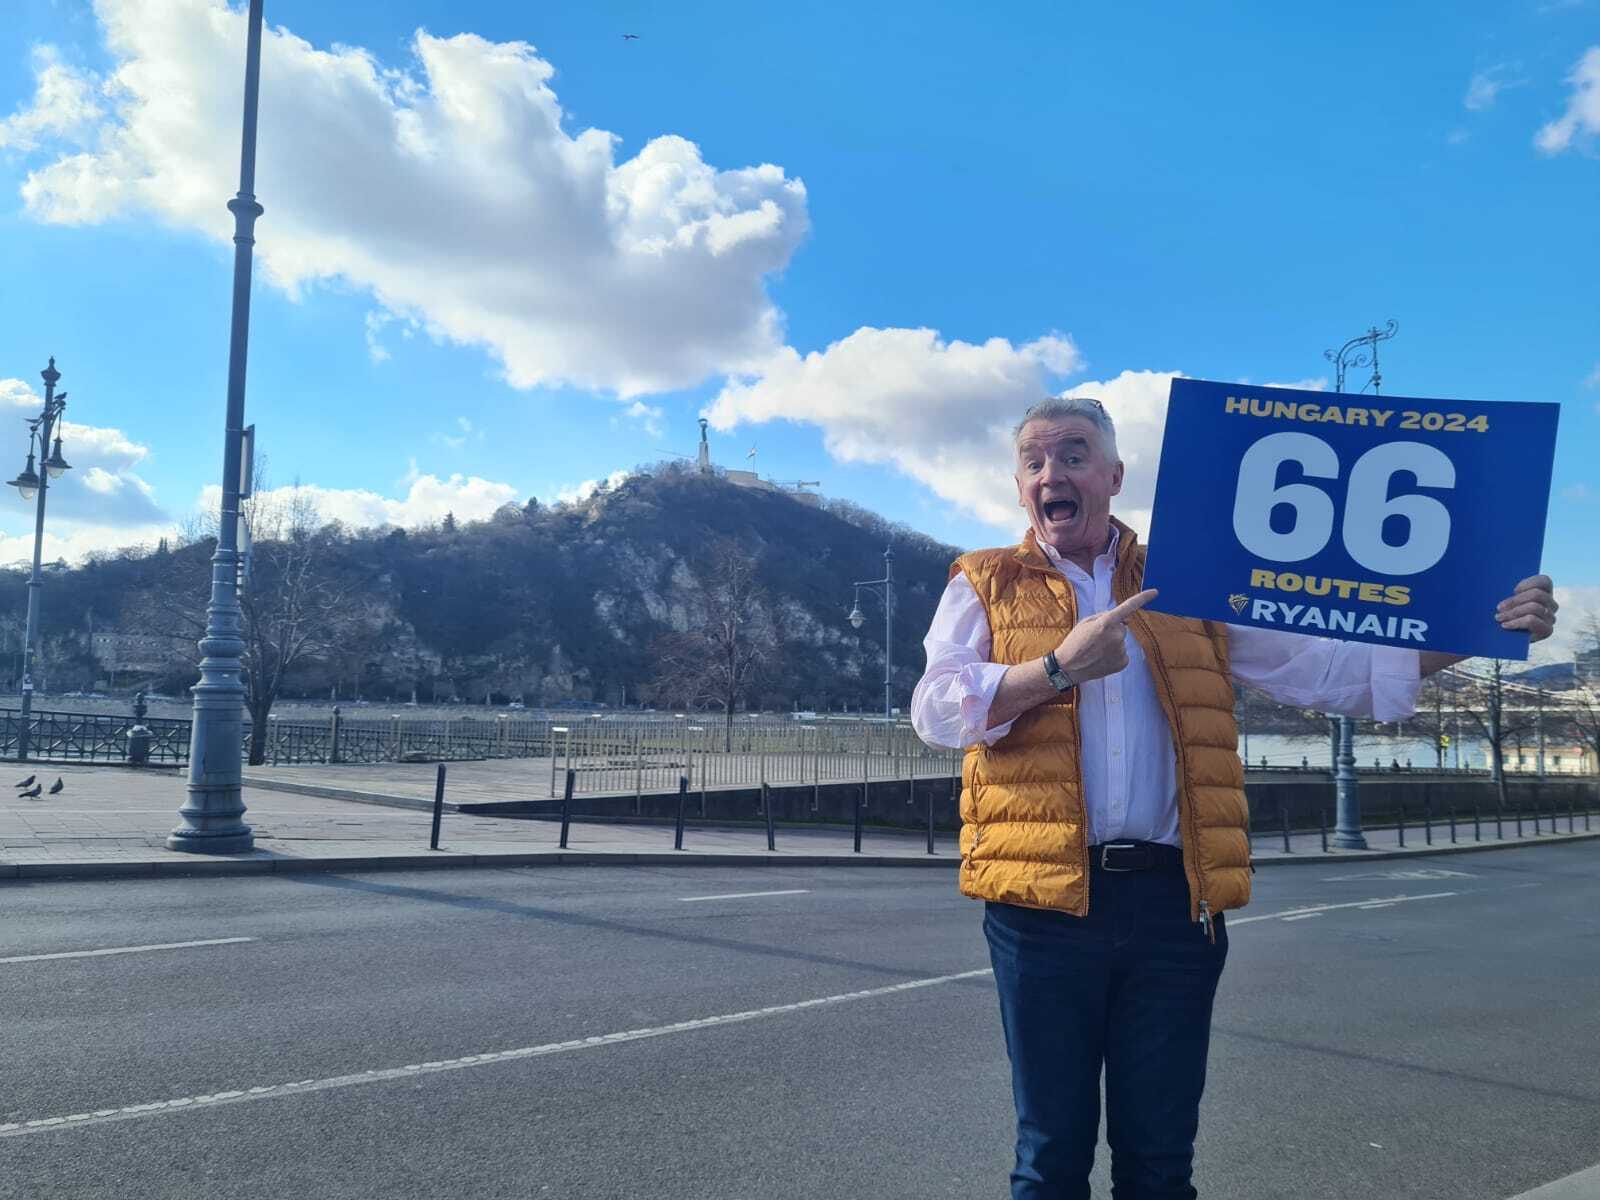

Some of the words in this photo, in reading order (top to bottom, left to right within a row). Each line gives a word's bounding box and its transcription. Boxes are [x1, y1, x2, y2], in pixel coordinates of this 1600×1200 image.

[1225, 397, 1393, 428] HUNGARY
[1400, 411, 1489, 433] 2024
[1233, 432, 1456, 575] 66
[1250, 569, 1410, 605] ROUTES
[1252, 599, 1428, 642] RYANAIR
